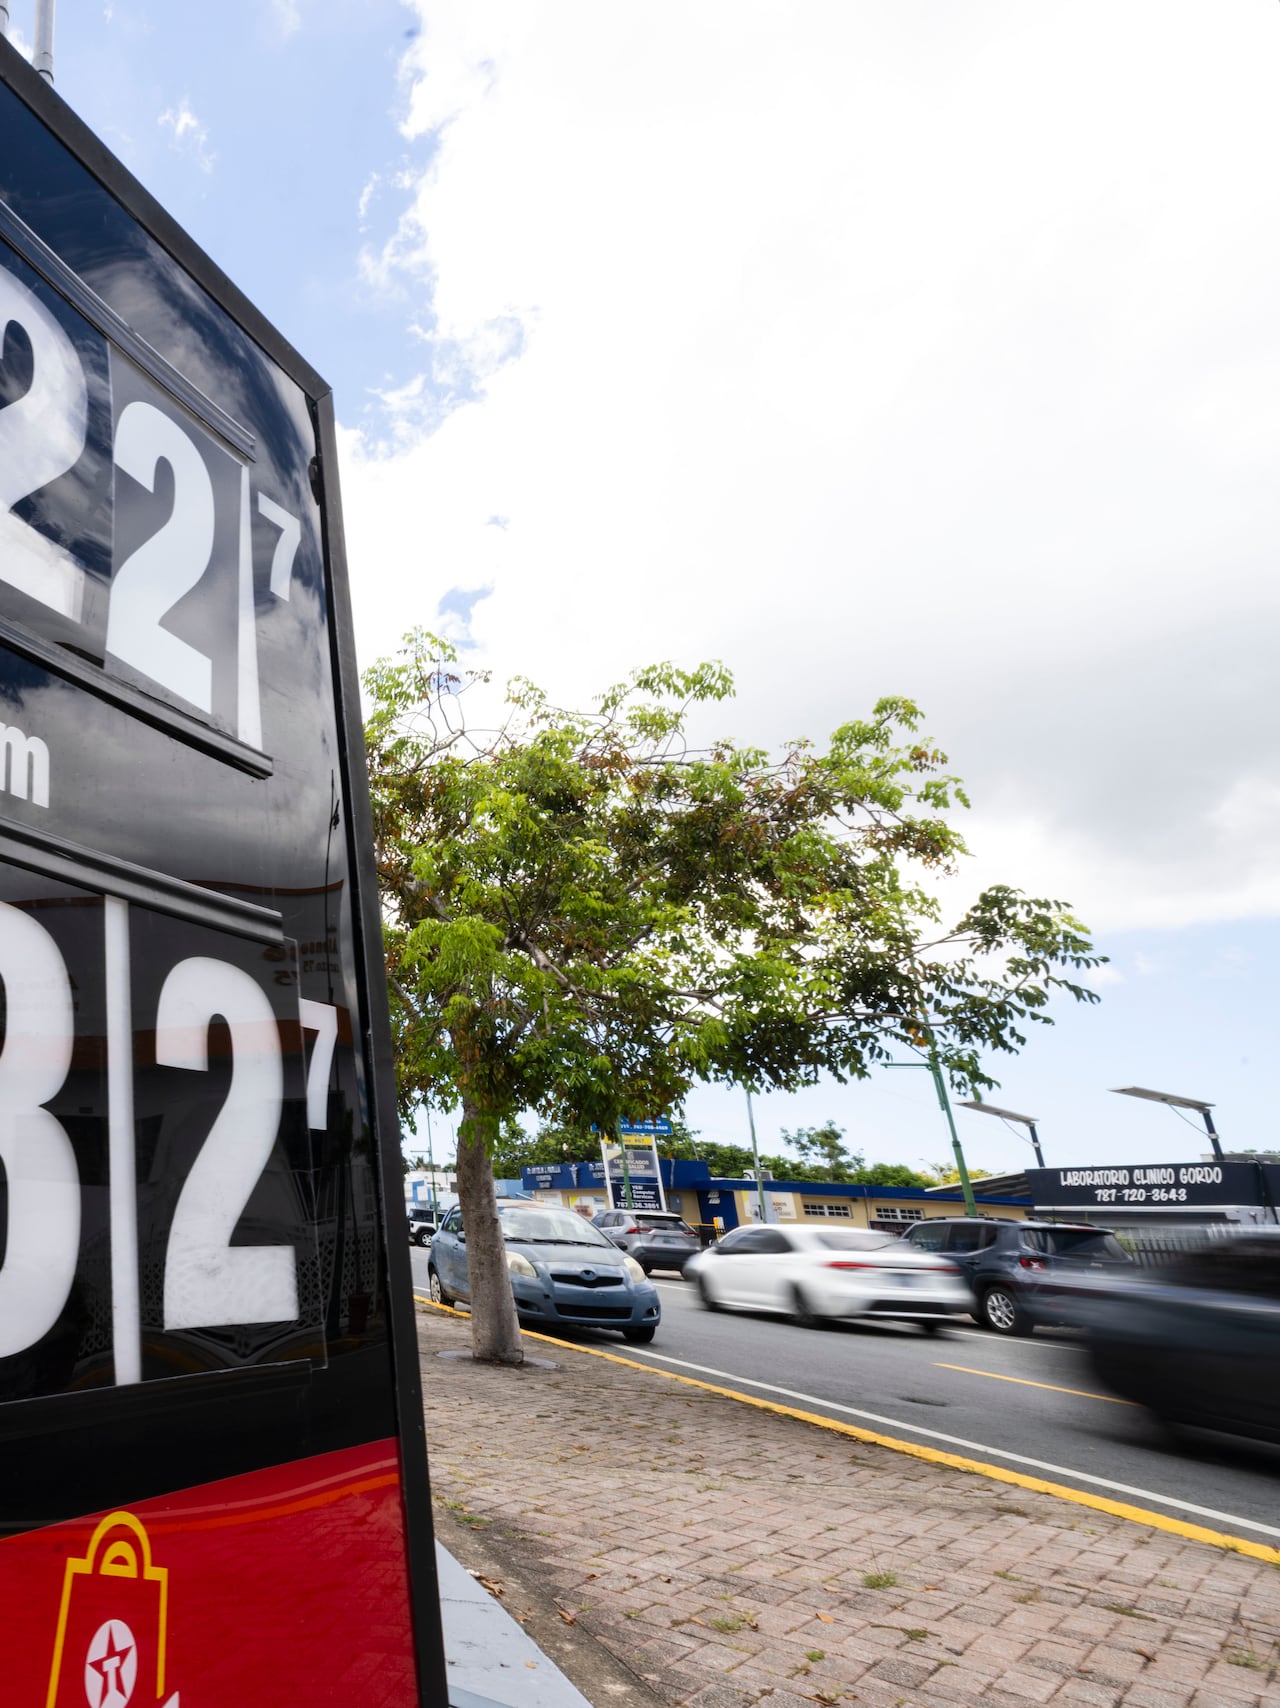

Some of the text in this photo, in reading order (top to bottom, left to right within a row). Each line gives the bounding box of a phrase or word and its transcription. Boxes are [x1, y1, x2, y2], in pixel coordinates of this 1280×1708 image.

[1060, 1166, 1222, 1187] LABORATORIO CLINICO GORDO
[1094, 1188, 1187, 1202] 787-720-3643
